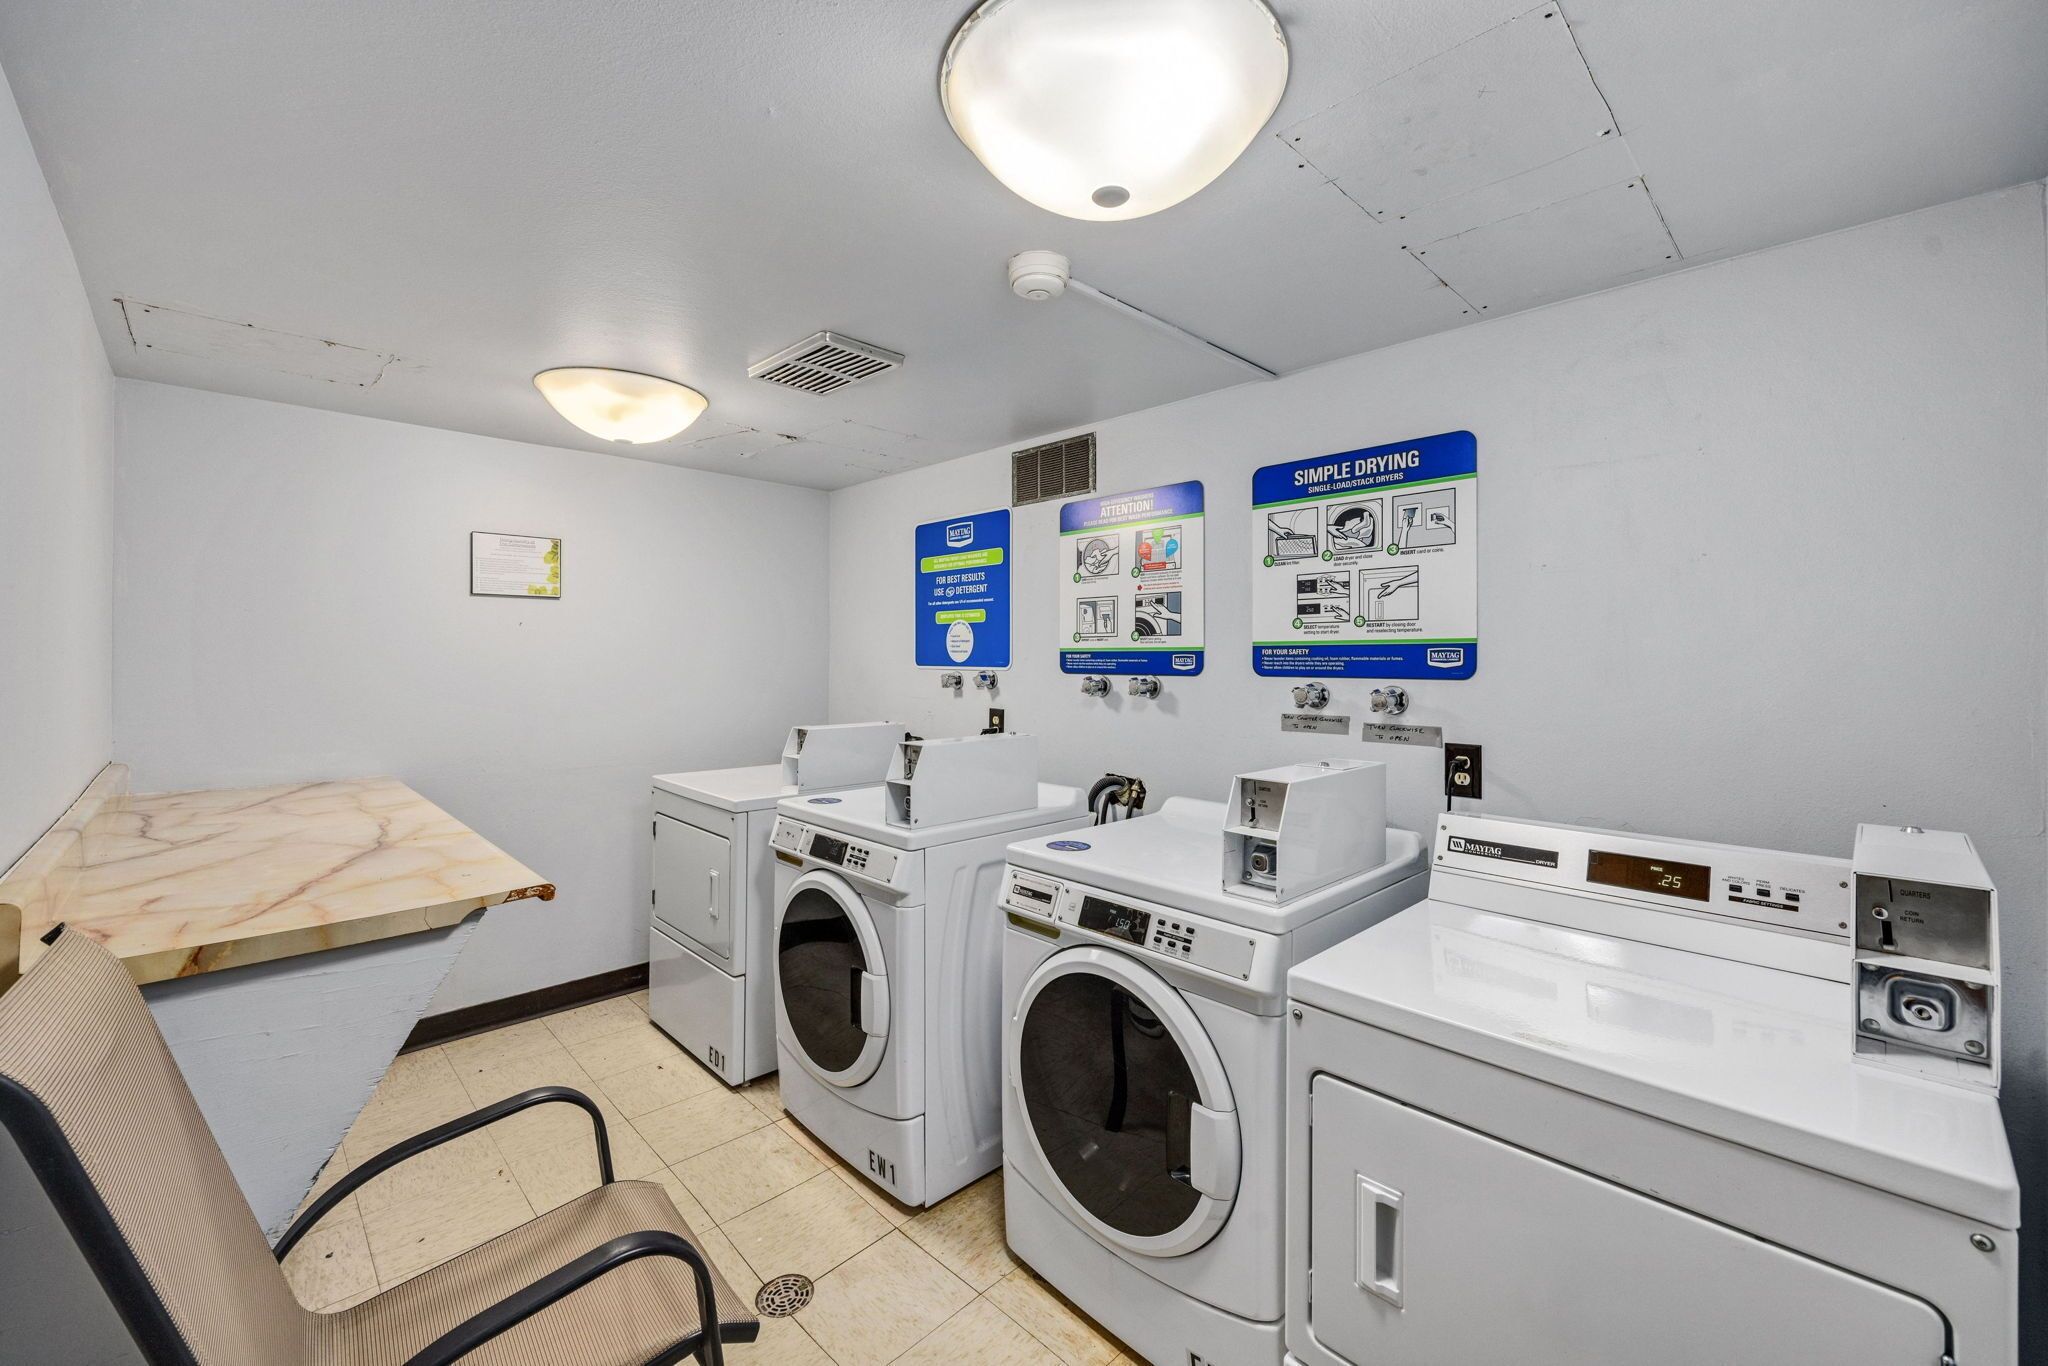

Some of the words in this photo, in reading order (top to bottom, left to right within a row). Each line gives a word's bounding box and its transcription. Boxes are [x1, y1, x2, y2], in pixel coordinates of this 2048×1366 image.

[1294, 462, 1351, 486] SIMPLE
[1355, 450, 1420, 477] DRYING
[1308, 476, 1374, 494] SINGLE-LOAD/STACK
[1376, 472, 1404, 484] DRYERS
[1100, 499, 1153, 518] ATTENTION!
[949, 527, 971, 537] MAYTAG
[936, 576, 947, 585] FOR
[947, 574, 961, 584] BEST
[961, 572, 986, 582] RESULTS
[933, 587, 945, 596] USE
[955, 583, 988, 595] DETERGENT
[1431, 651, 1460, 659] MAYTAG
[1366, 723, 1386, 731] TURN
[1389, 725, 1425, 734] CLOCKWISE
[1464, 842, 1502, 855] MAYTAG
[1464, 849, 1502, 858] COMMERCIAL
[1535, 859, 1557, 867] DRYER
[1657, 874, 1683, 889] .25
[1779, 886, 1806, 894] DELICATES
[1899, 888, 1931, 900] QUARTERS
[1742, 898, 1760, 906] FABRIC
[1760, 900, 1784, 909] SETTINGS
[1904, 909, 1919, 917] COIN
[1899, 916, 1925, 925] RETURN
[709, 1045, 725, 1072] ED1
